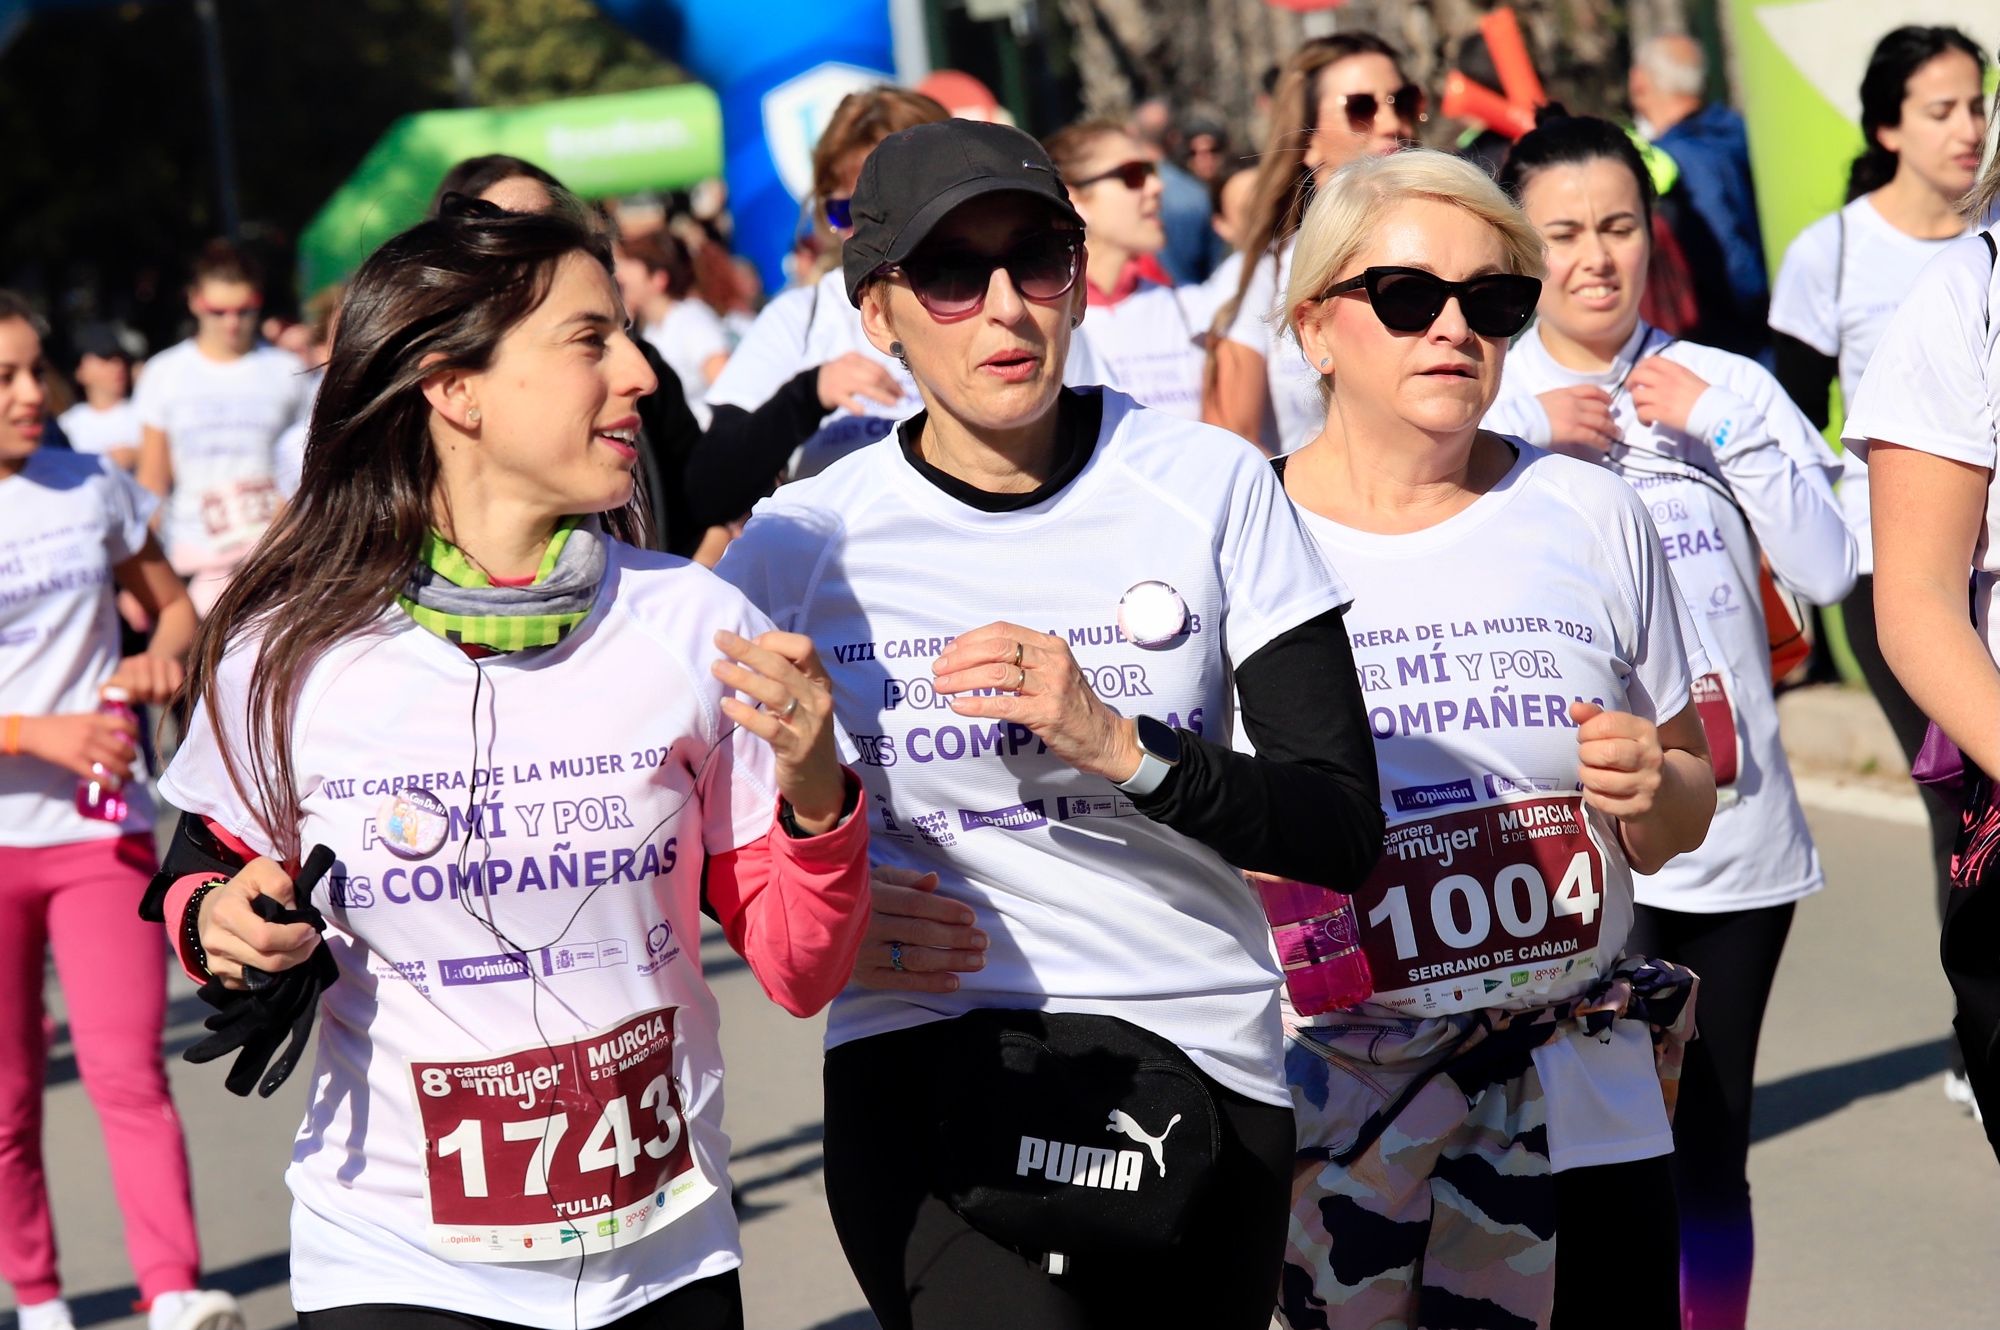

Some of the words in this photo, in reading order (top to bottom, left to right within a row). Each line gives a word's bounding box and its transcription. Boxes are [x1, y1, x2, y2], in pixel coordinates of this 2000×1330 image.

[1651, 499, 1688, 525] OR
[833, 642, 876, 664] VIII
[1351, 627, 1410, 648] RERA
[1415, 624, 1444, 640] DE
[1451, 621, 1478, 637] LA
[1483, 617, 1551, 634] MUJER
[1554, 620, 1592, 643] 2023
[1396, 642, 1451, 686] MÍ
[1456, 653, 1482, 681] Y
[1490, 650, 1562, 679] POR
[1368, 685, 1604, 740] OMPAÑER
[323, 779, 355, 800] VIII
[363, 771, 466, 796] CARRERA
[475, 767, 505, 788] DE
[514, 763, 542, 784] LA
[550, 754, 625, 780] MUJER
[450, 790, 506, 841] MÍ
[515, 803, 545, 837] Y
[553, 796, 634, 835] POR
[1498, 804, 1575, 831] MURCIA
[1502, 836, 1509, 844] 5
[1512, 832, 1526, 843] DE
[1528, 826, 1563, 840] MARZO
[1563, 825, 1580, 835] 2023
[1399, 825, 1480, 867] mujer
[383, 838, 677, 904] COMPAÑERAS
[1368, 852, 1600, 960] 1004
[1408, 954, 1490, 982] SERRANO
[1493, 949, 1514, 964] DE
[1519, 940, 1579, 960] CAÑADA
[588, 1015, 665, 1067] MURCIA
[590, 1070, 599, 1080] 5
[602, 1064, 618, 1078] DE
[619, 1048, 650, 1071] MARZO
[650, 1036, 669, 1054] 2023
[453, 1061, 515, 1078] carrera
[474, 1063, 564, 1109] mujer
[438, 1074, 681, 1198] 1743
[1016, 1135, 1144, 1191] PUMA
[552, 1194, 613, 1217] TULIA
